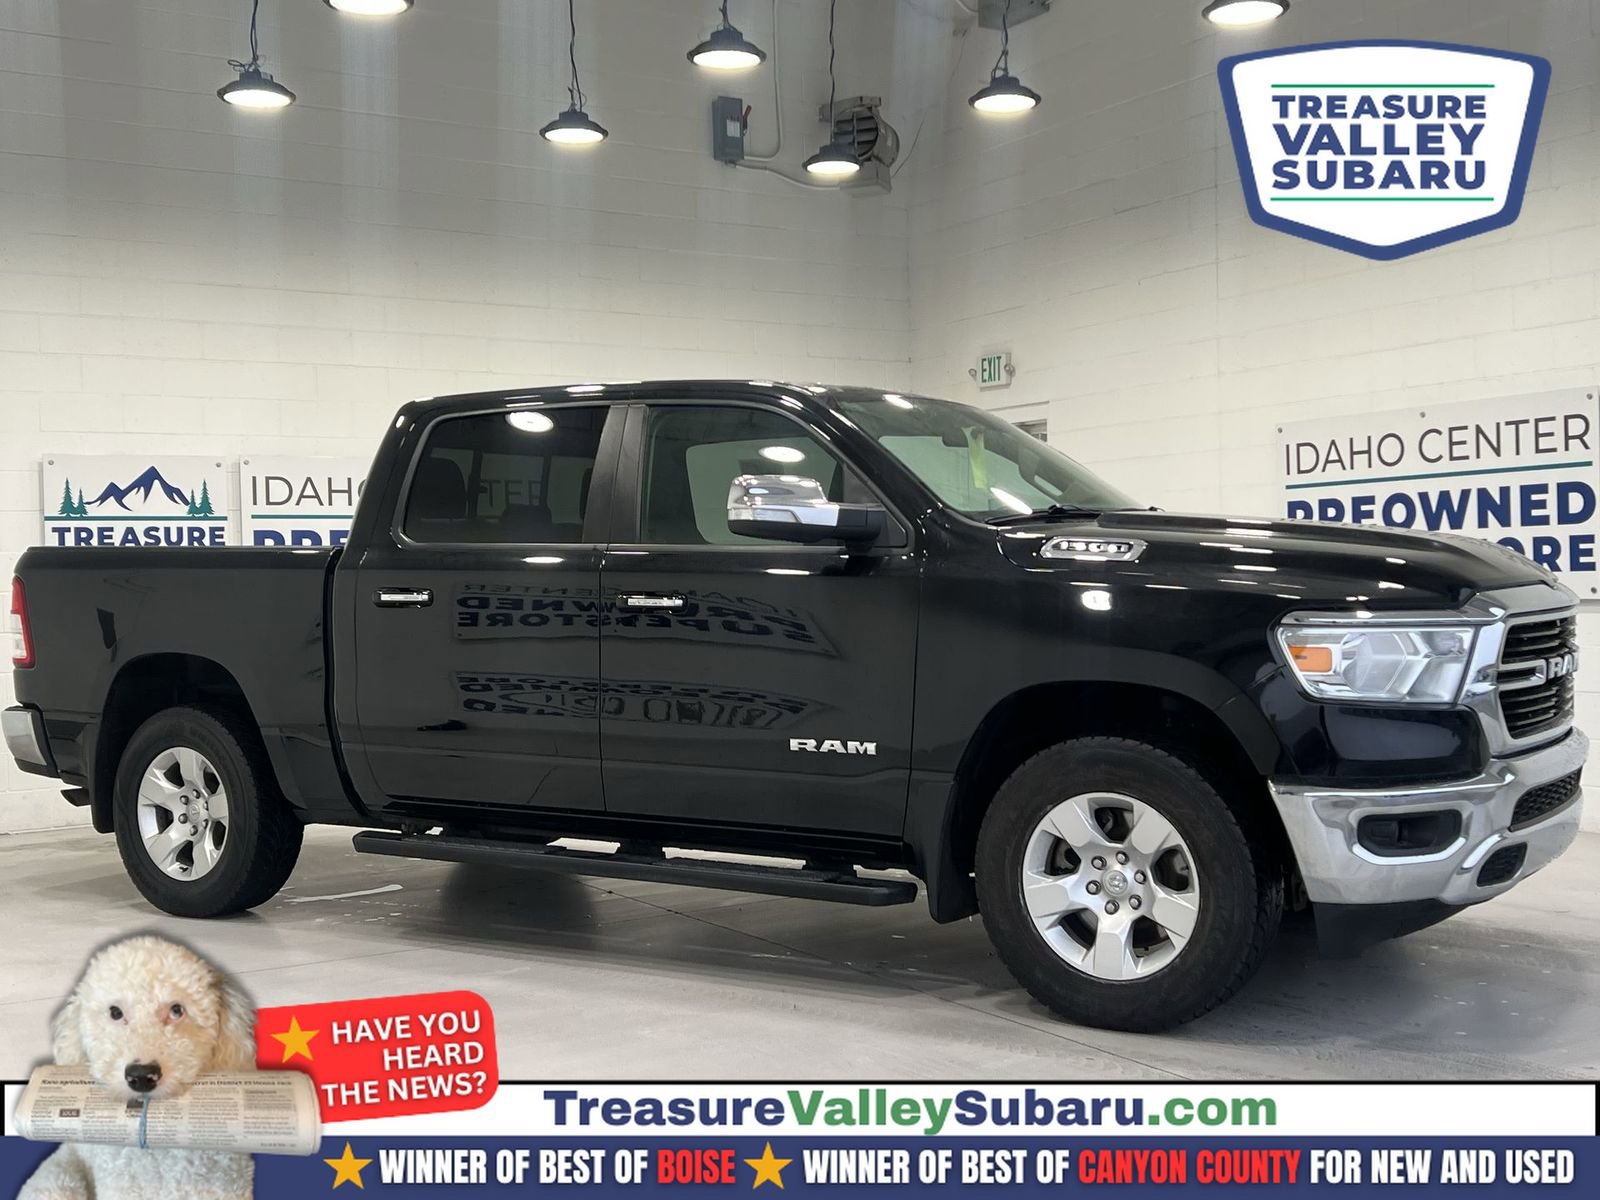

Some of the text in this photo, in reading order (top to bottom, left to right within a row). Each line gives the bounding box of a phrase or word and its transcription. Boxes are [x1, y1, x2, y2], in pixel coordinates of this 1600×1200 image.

[981, 355, 1002, 383] EXIT
[1285, 413, 1591, 476] IDAHO CENTER
[51, 526, 226, 547] TREASURE
[789, 738, 877, 755] RAM
